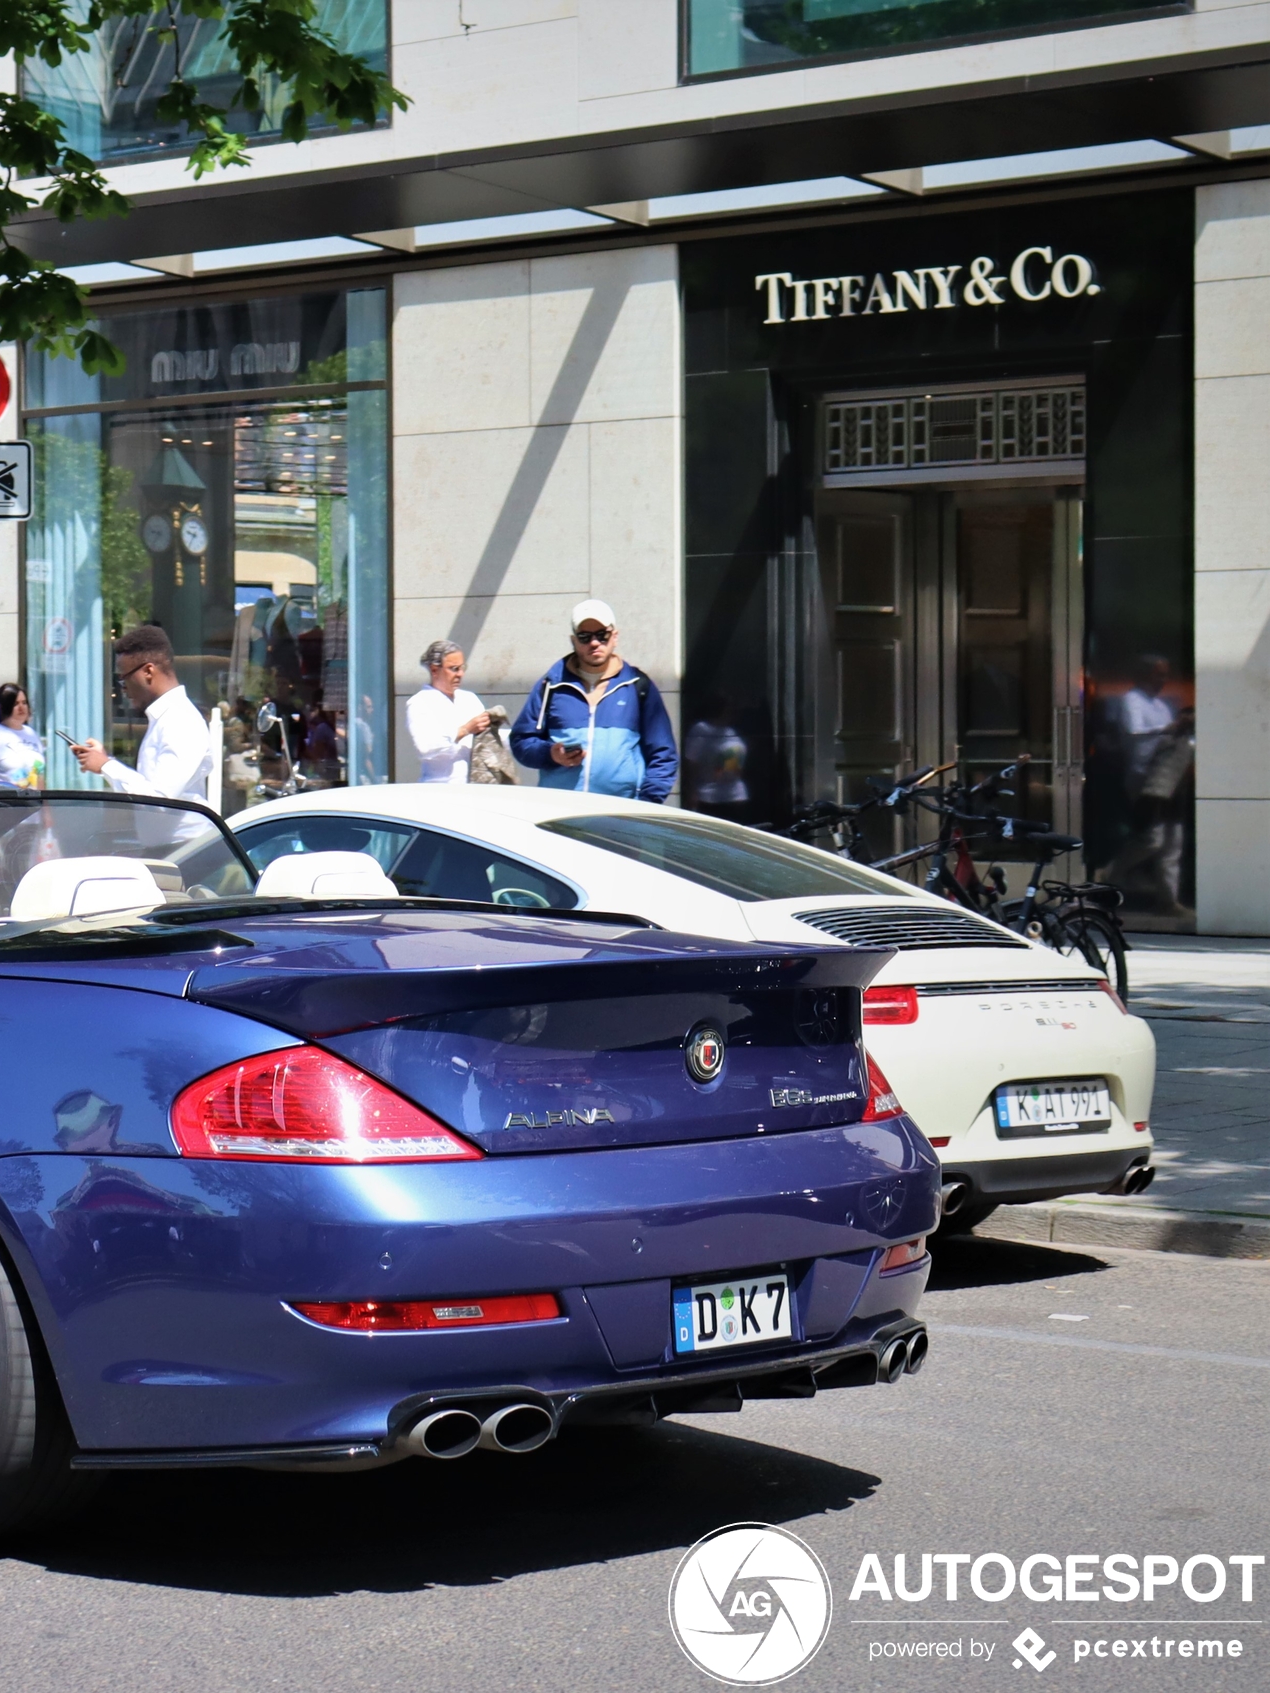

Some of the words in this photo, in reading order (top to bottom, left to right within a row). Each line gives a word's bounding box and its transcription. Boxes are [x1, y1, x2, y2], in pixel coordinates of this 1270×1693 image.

[503, 1107, 615, 1130] ALPINA
[1016, 1089, 1031, 1121] K
[1044, 1087, 1066, 1119] AT
[1070, 1084, 1102, 1117] 991
[695, 1292, 718, 1342] D
